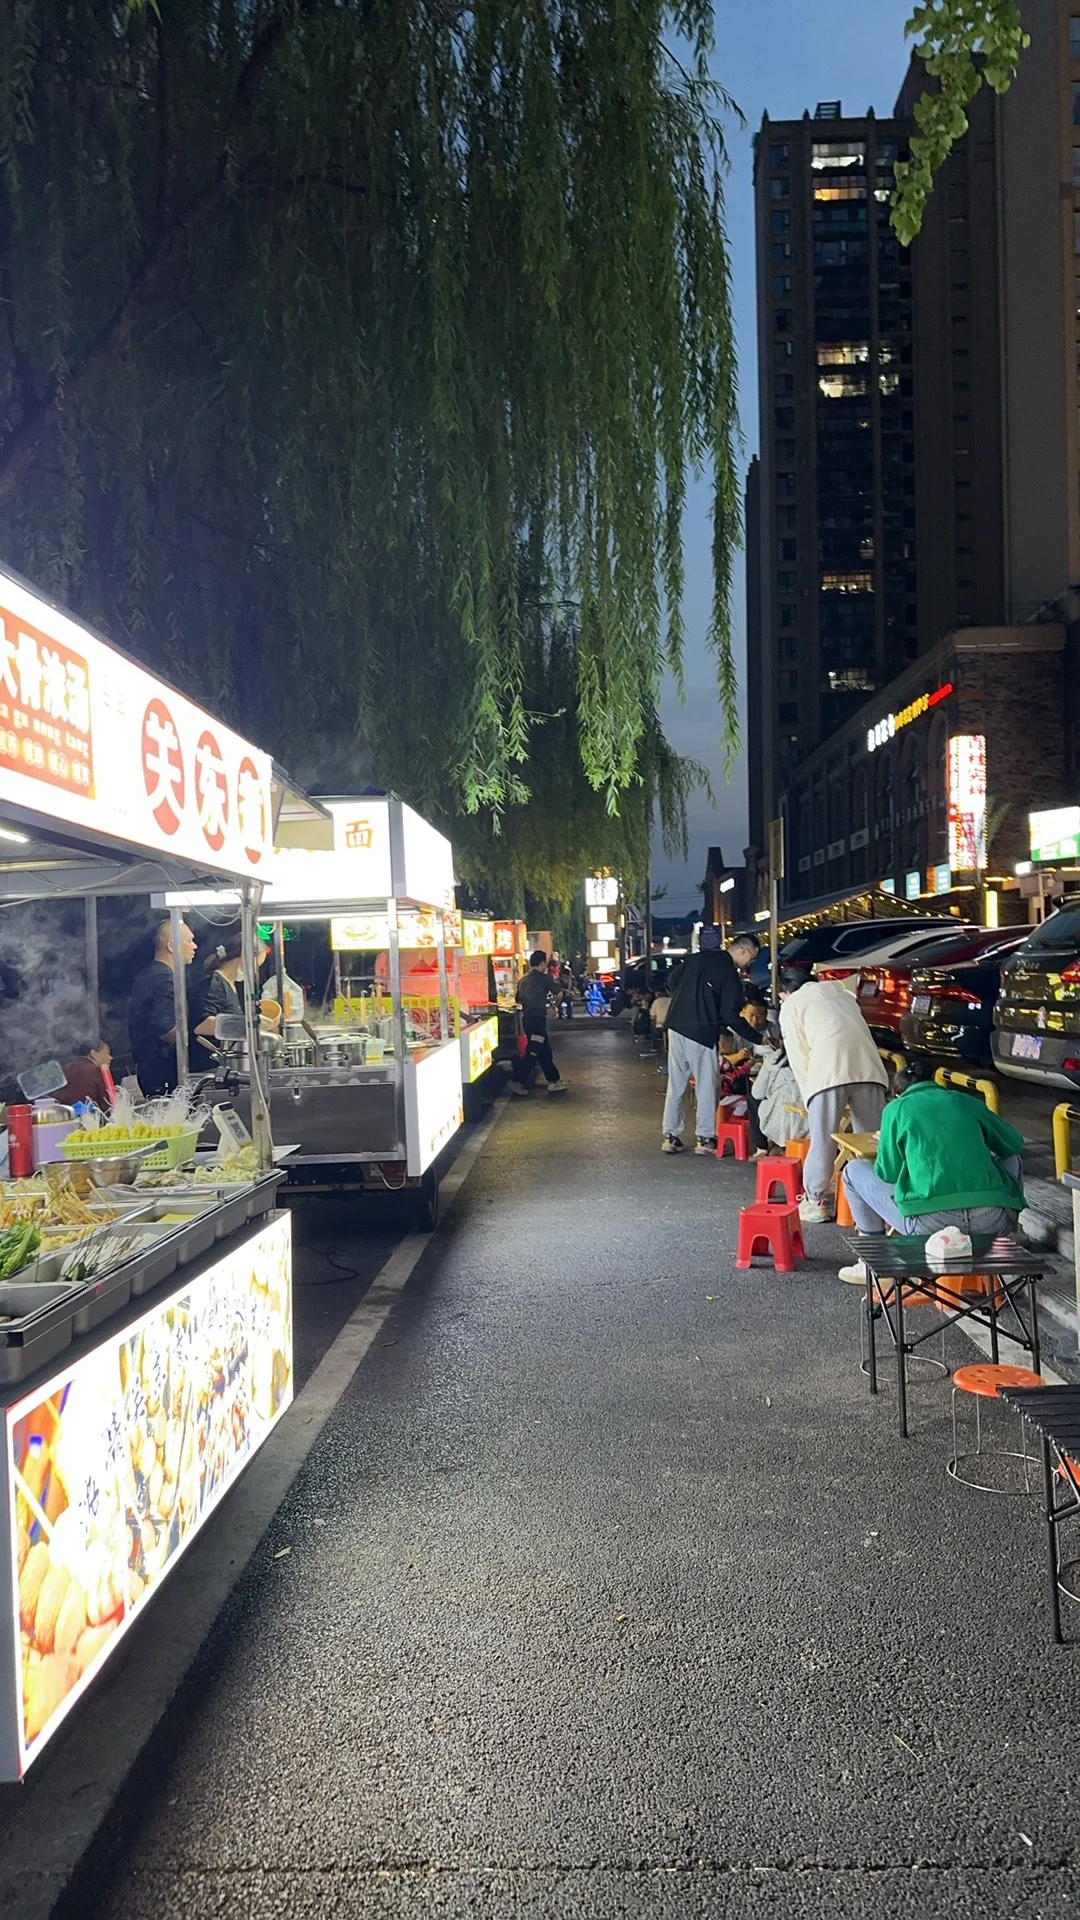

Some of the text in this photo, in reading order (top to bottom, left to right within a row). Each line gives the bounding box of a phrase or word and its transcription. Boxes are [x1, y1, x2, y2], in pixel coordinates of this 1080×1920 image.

[13, 709, 29, 730] gu
[32, 717, 62, 747] nong
[65, 730, 89, 760] tang
[344, 818, 374, 849] 面
